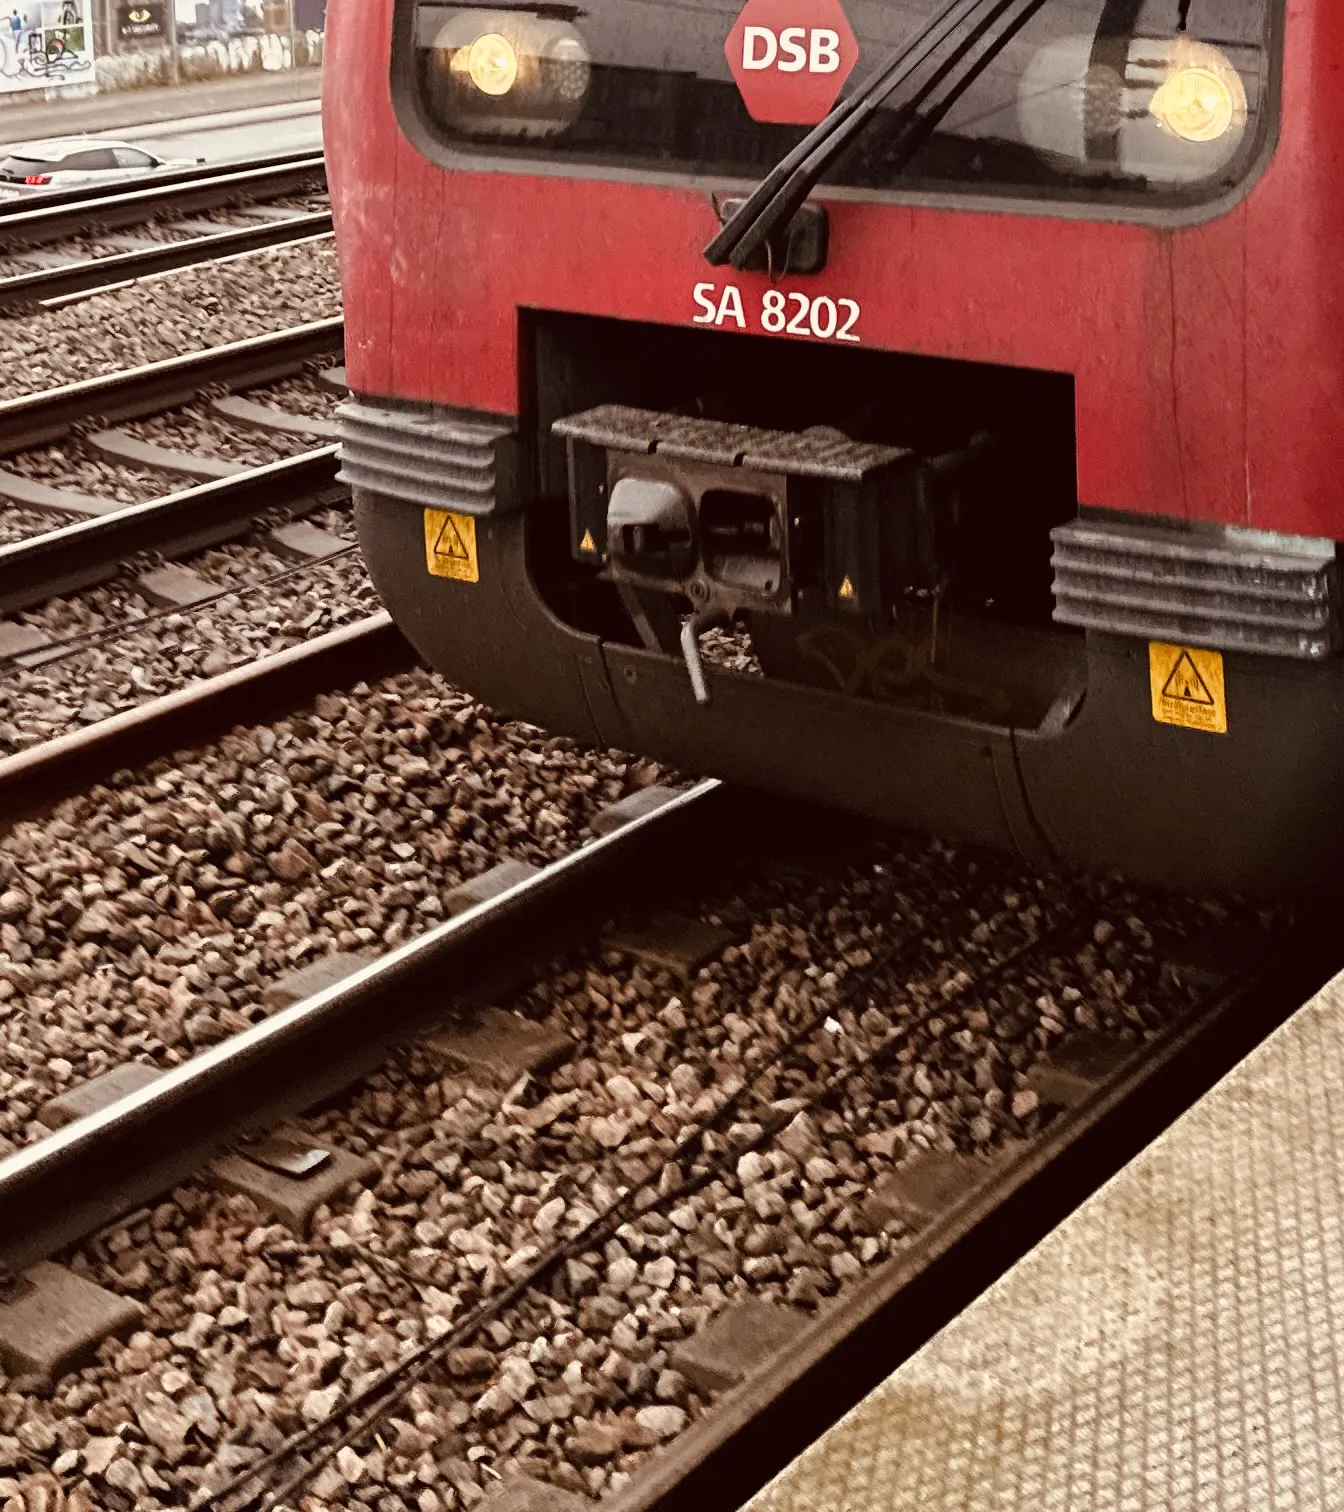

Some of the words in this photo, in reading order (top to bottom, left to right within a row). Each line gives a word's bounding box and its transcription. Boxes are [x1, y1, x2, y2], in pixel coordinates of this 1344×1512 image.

[742, 26, 840, 73] DSB
[692, 282, 746, 328] SA
[760, 290, 861, 342] 8202
